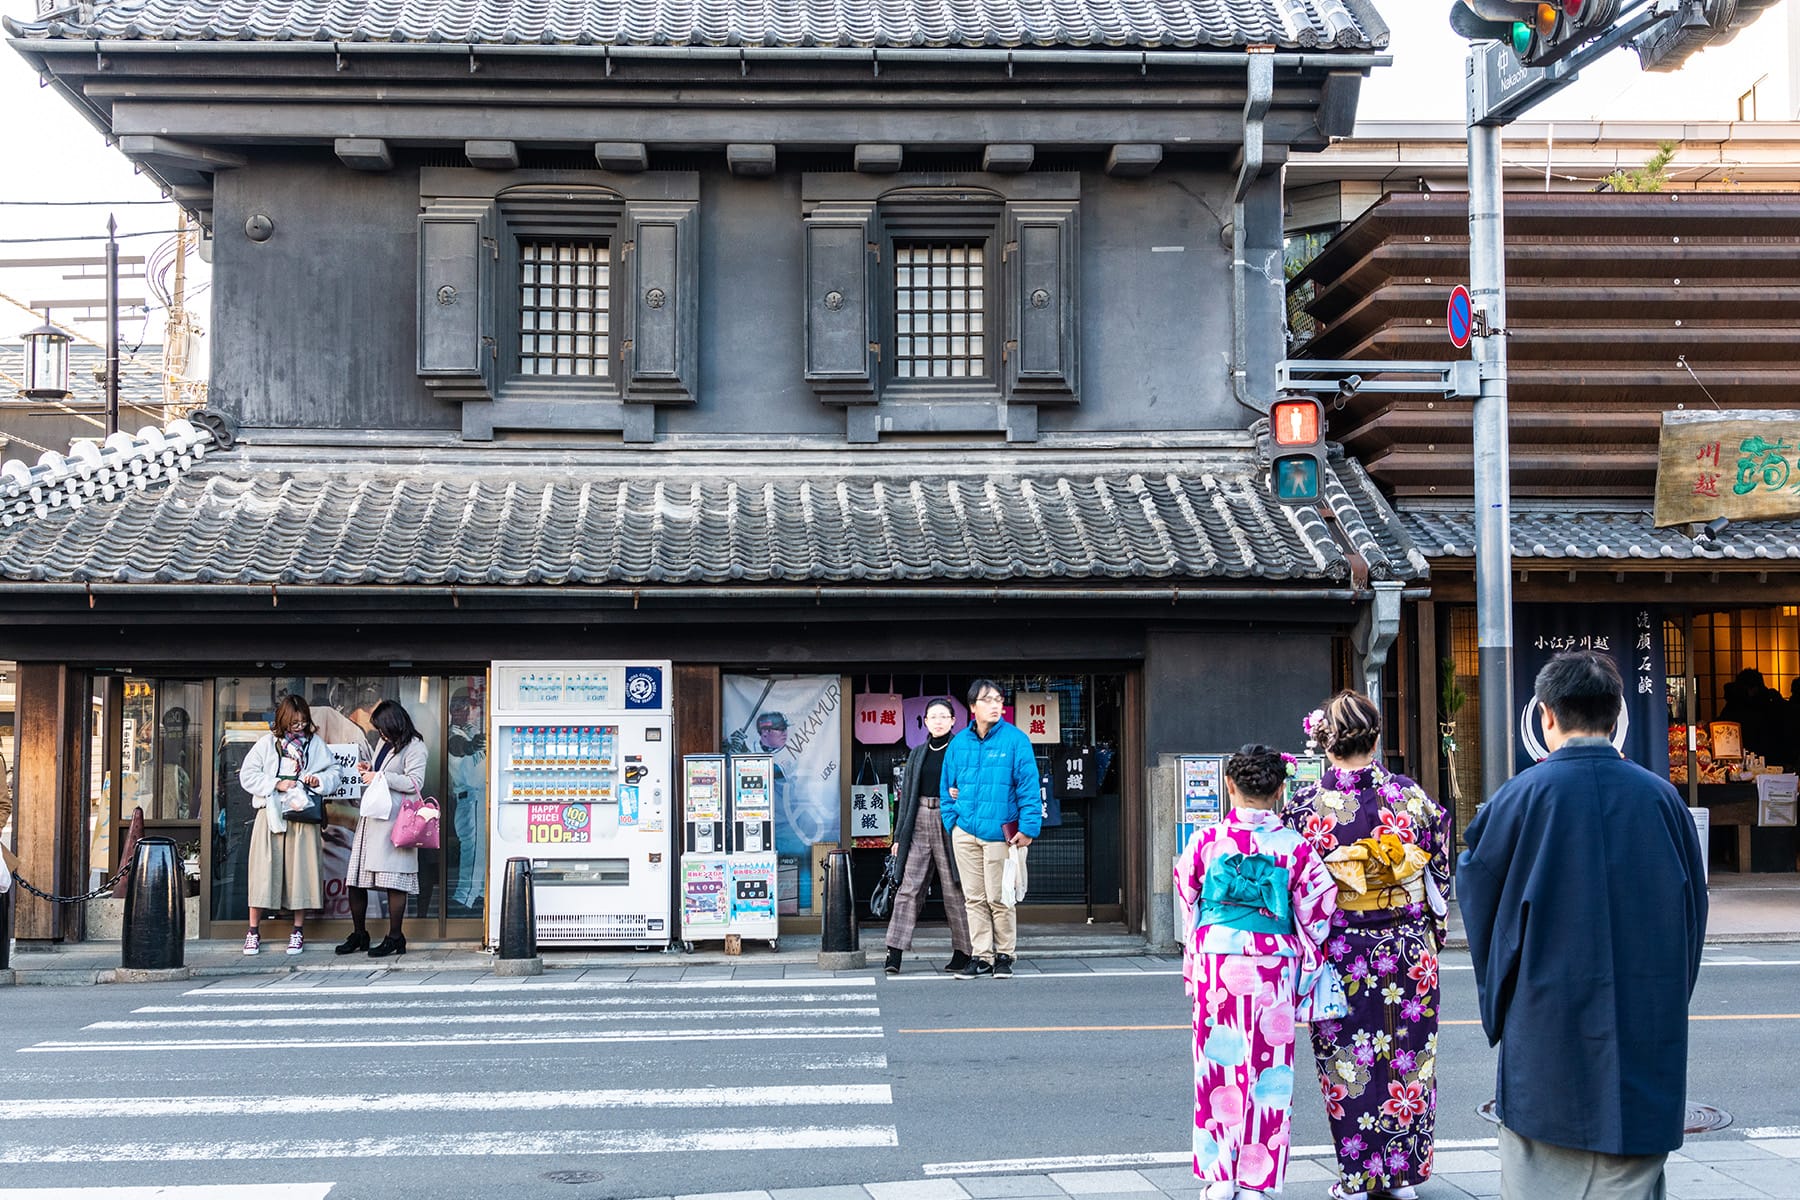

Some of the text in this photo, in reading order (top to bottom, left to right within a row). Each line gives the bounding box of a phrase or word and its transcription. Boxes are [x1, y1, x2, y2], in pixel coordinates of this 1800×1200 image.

[1501, 66, 1528, 92] Nakacho
[1692, 441, 1721, 498] 川越
[1534, 635, 1610, 650] 小江戸川越
[785, 678, 842, 760] NAKAMUR
[860, 710, 897, 726] 川越
[1029, 703, 1046, 735] 川越
[1066, 758, 1084, 791] 川越
[532, 805, 559, 813] HAPPY
[532, 814, 559, 822] PRICE!
[567, 807, 587, 822] 100
[530, 824, 588, 843] 100円より
